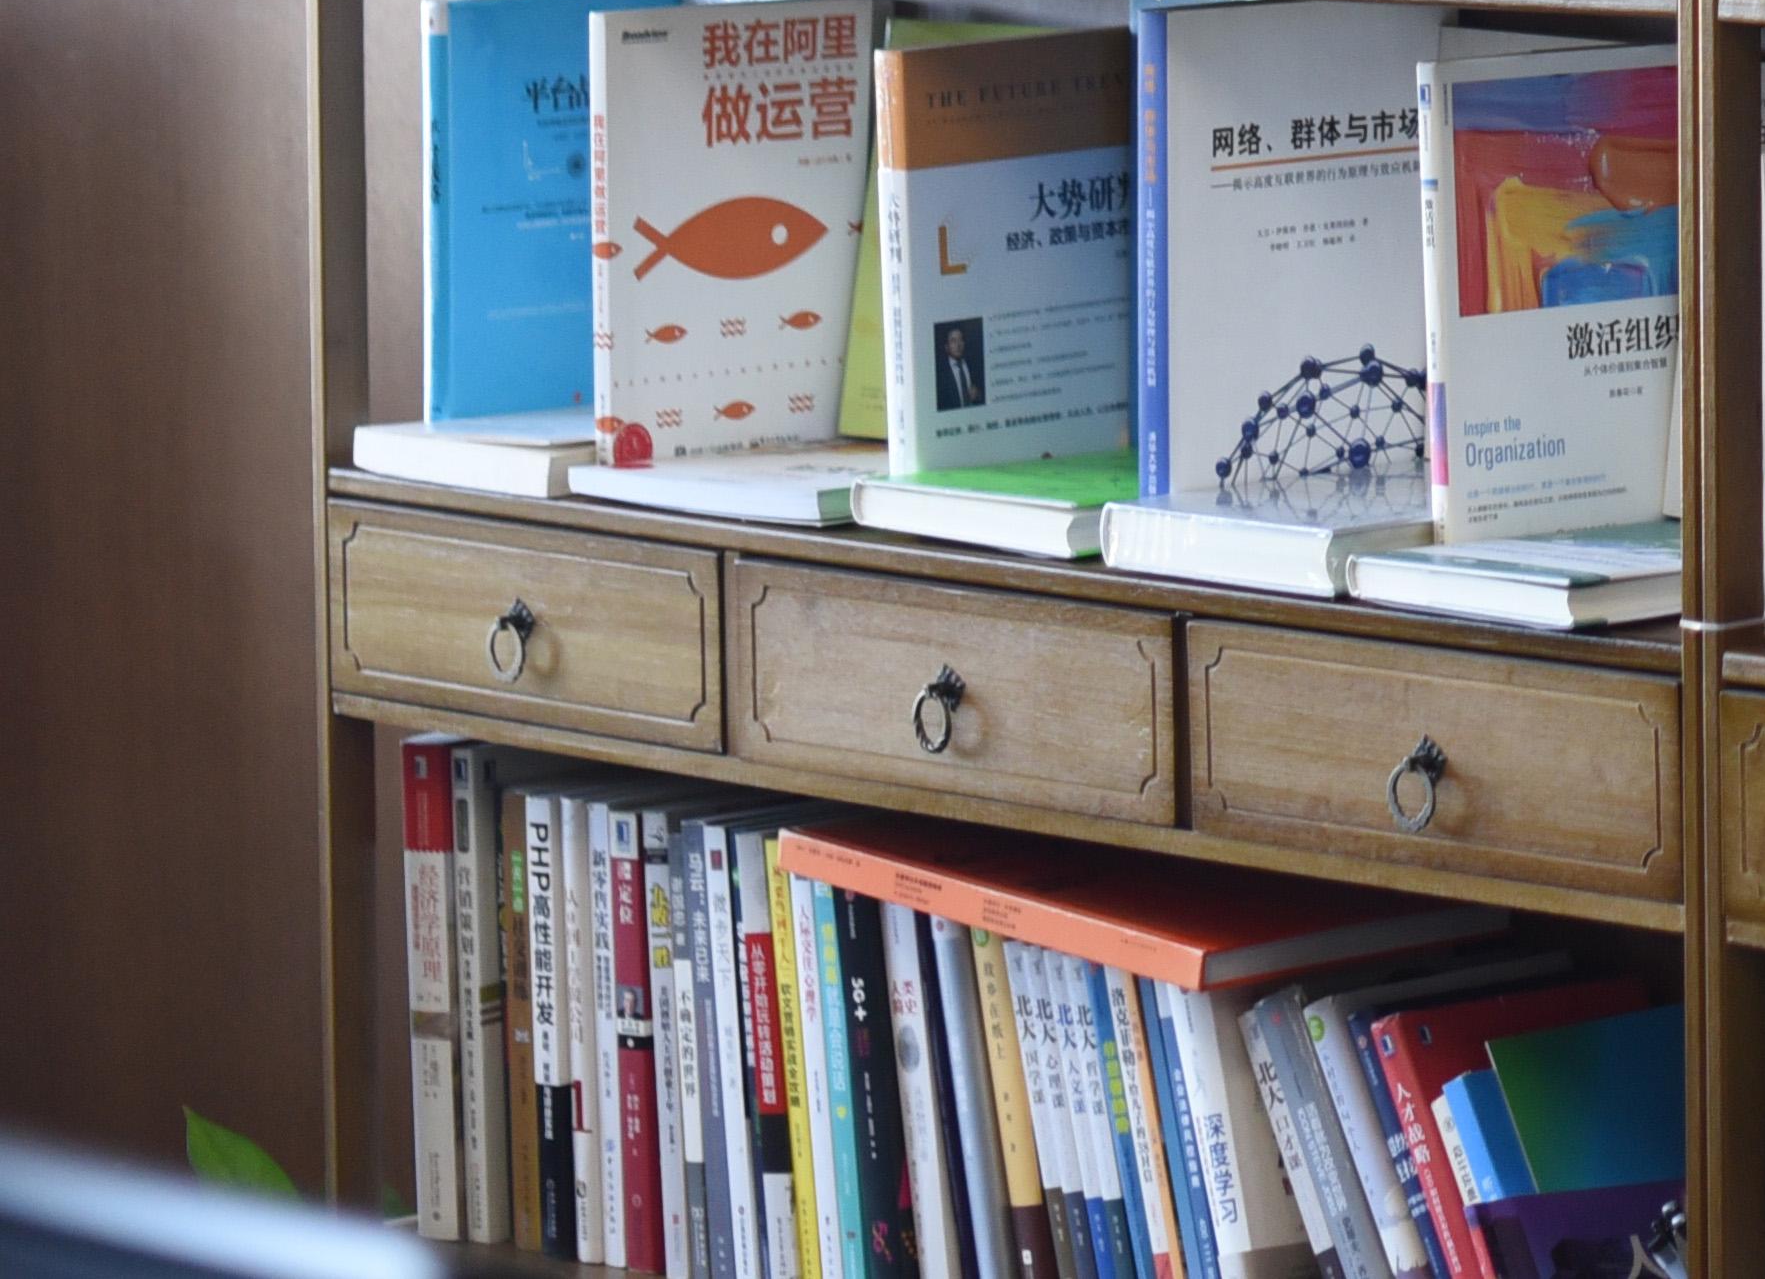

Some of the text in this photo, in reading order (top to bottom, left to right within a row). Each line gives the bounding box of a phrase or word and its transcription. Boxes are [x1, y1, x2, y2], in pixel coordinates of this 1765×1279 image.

[702, 14, 859, 70] 我在阿里
[702, 75, 859, 148] 做运营
[927, 77, 1062, 110] THE FUTURE
[1212, 107, 1419, 158] 网络、群体与市场
[1566, 314, 1680, 361] 激活组织
[1463, 415, 1522, 438] Inspire the
[1465, 433, 1567, 471] Organization
[530, 822, 555, 1027] PHP高性能开发
[1016, 995, 1037, 1041] 北大
[1036, 999, 1057, 1045] 北大
[1056, 1003, 1078, 1051] 北大
[1076, 1004, 1097, 1051] 北大
[1258, 1060, 1285, 1111] 北大
[1396, 1082, 1432, 1165] 人才战略
[1203, 1112, 1239, 1225] 深度学习
